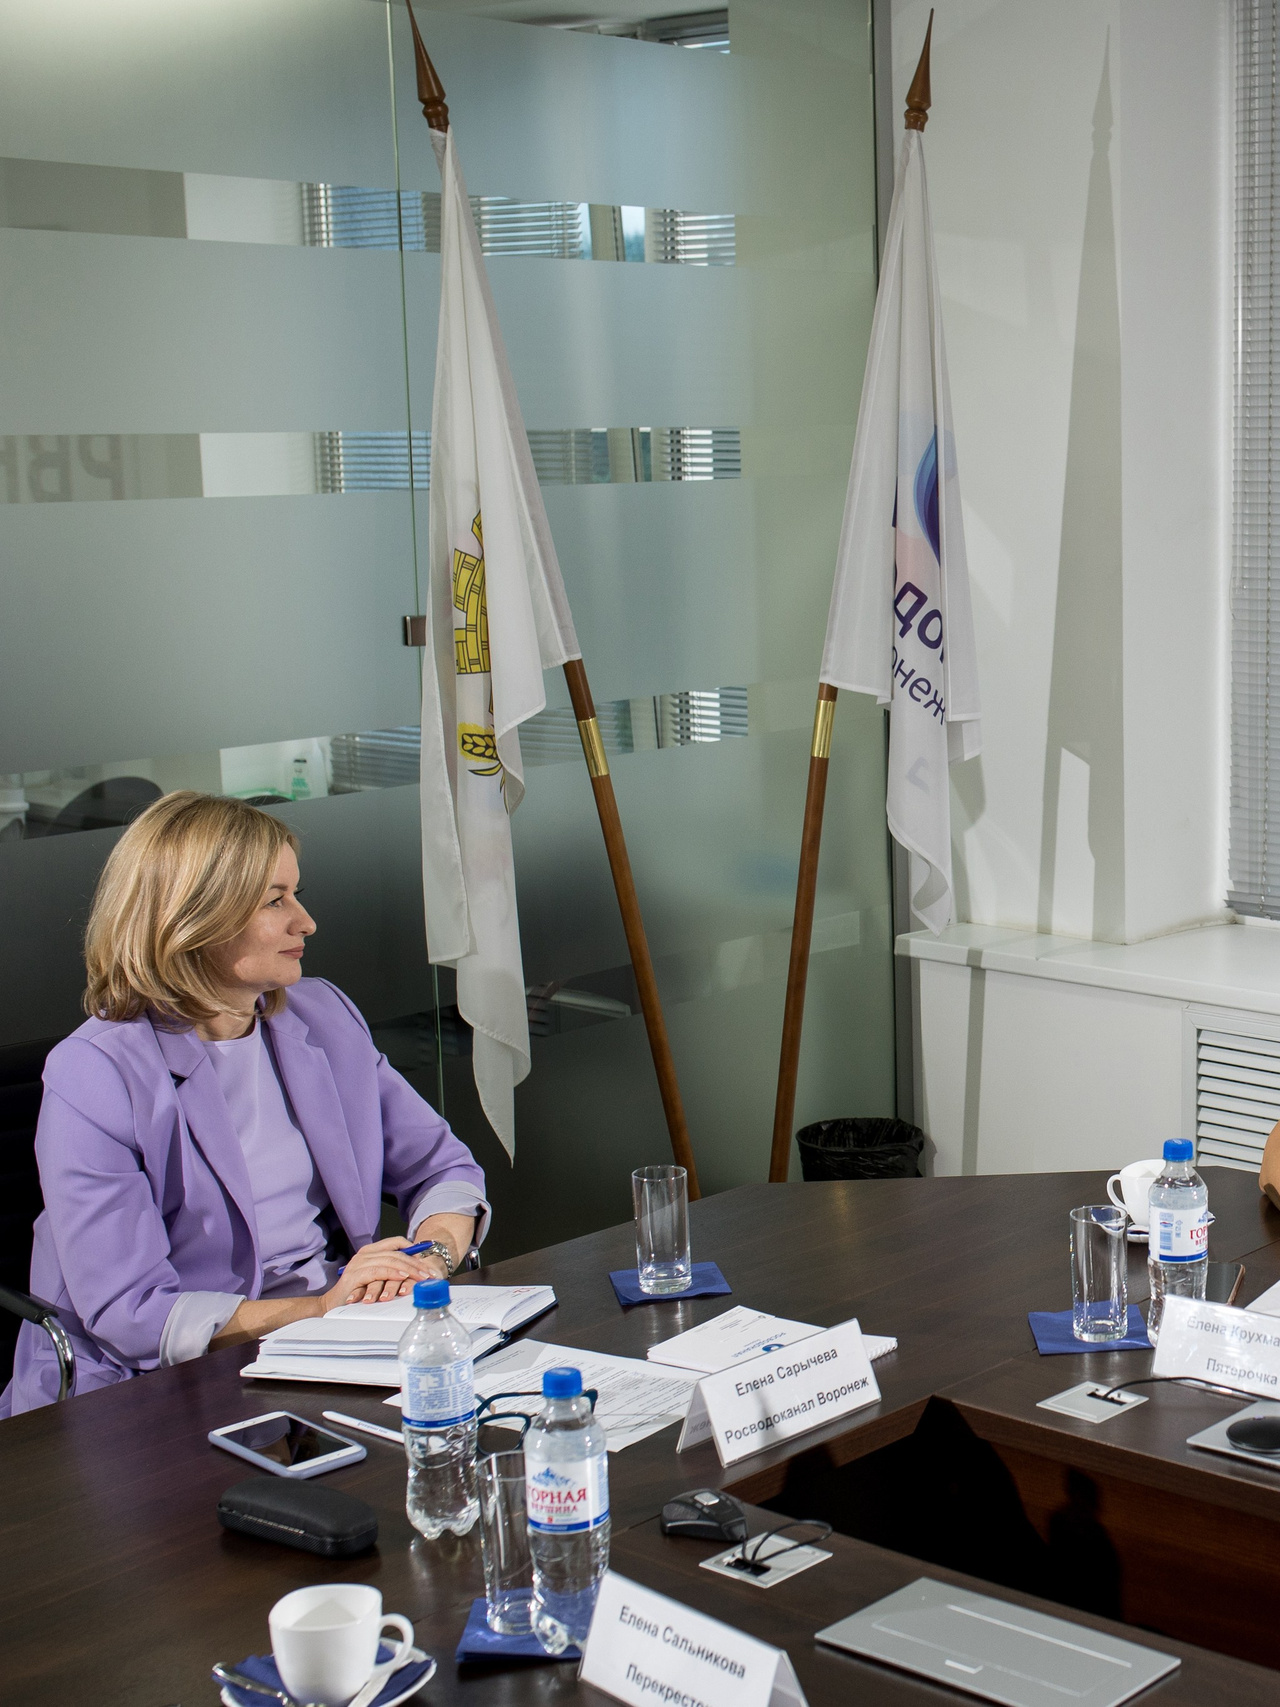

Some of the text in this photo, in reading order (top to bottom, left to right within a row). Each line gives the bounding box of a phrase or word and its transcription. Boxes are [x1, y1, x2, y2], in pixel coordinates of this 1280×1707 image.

[1187, 1316, 1227, 1336] Елена
[735, 1346, 838, 1397] Елена Сарычева
[1205, 1357, 1279, 1386] Пятерочка
[725, 1375, 870, 1444] Росводоканал Воронеж
[618, 1605, 747, 1680] Елена Сальникова
